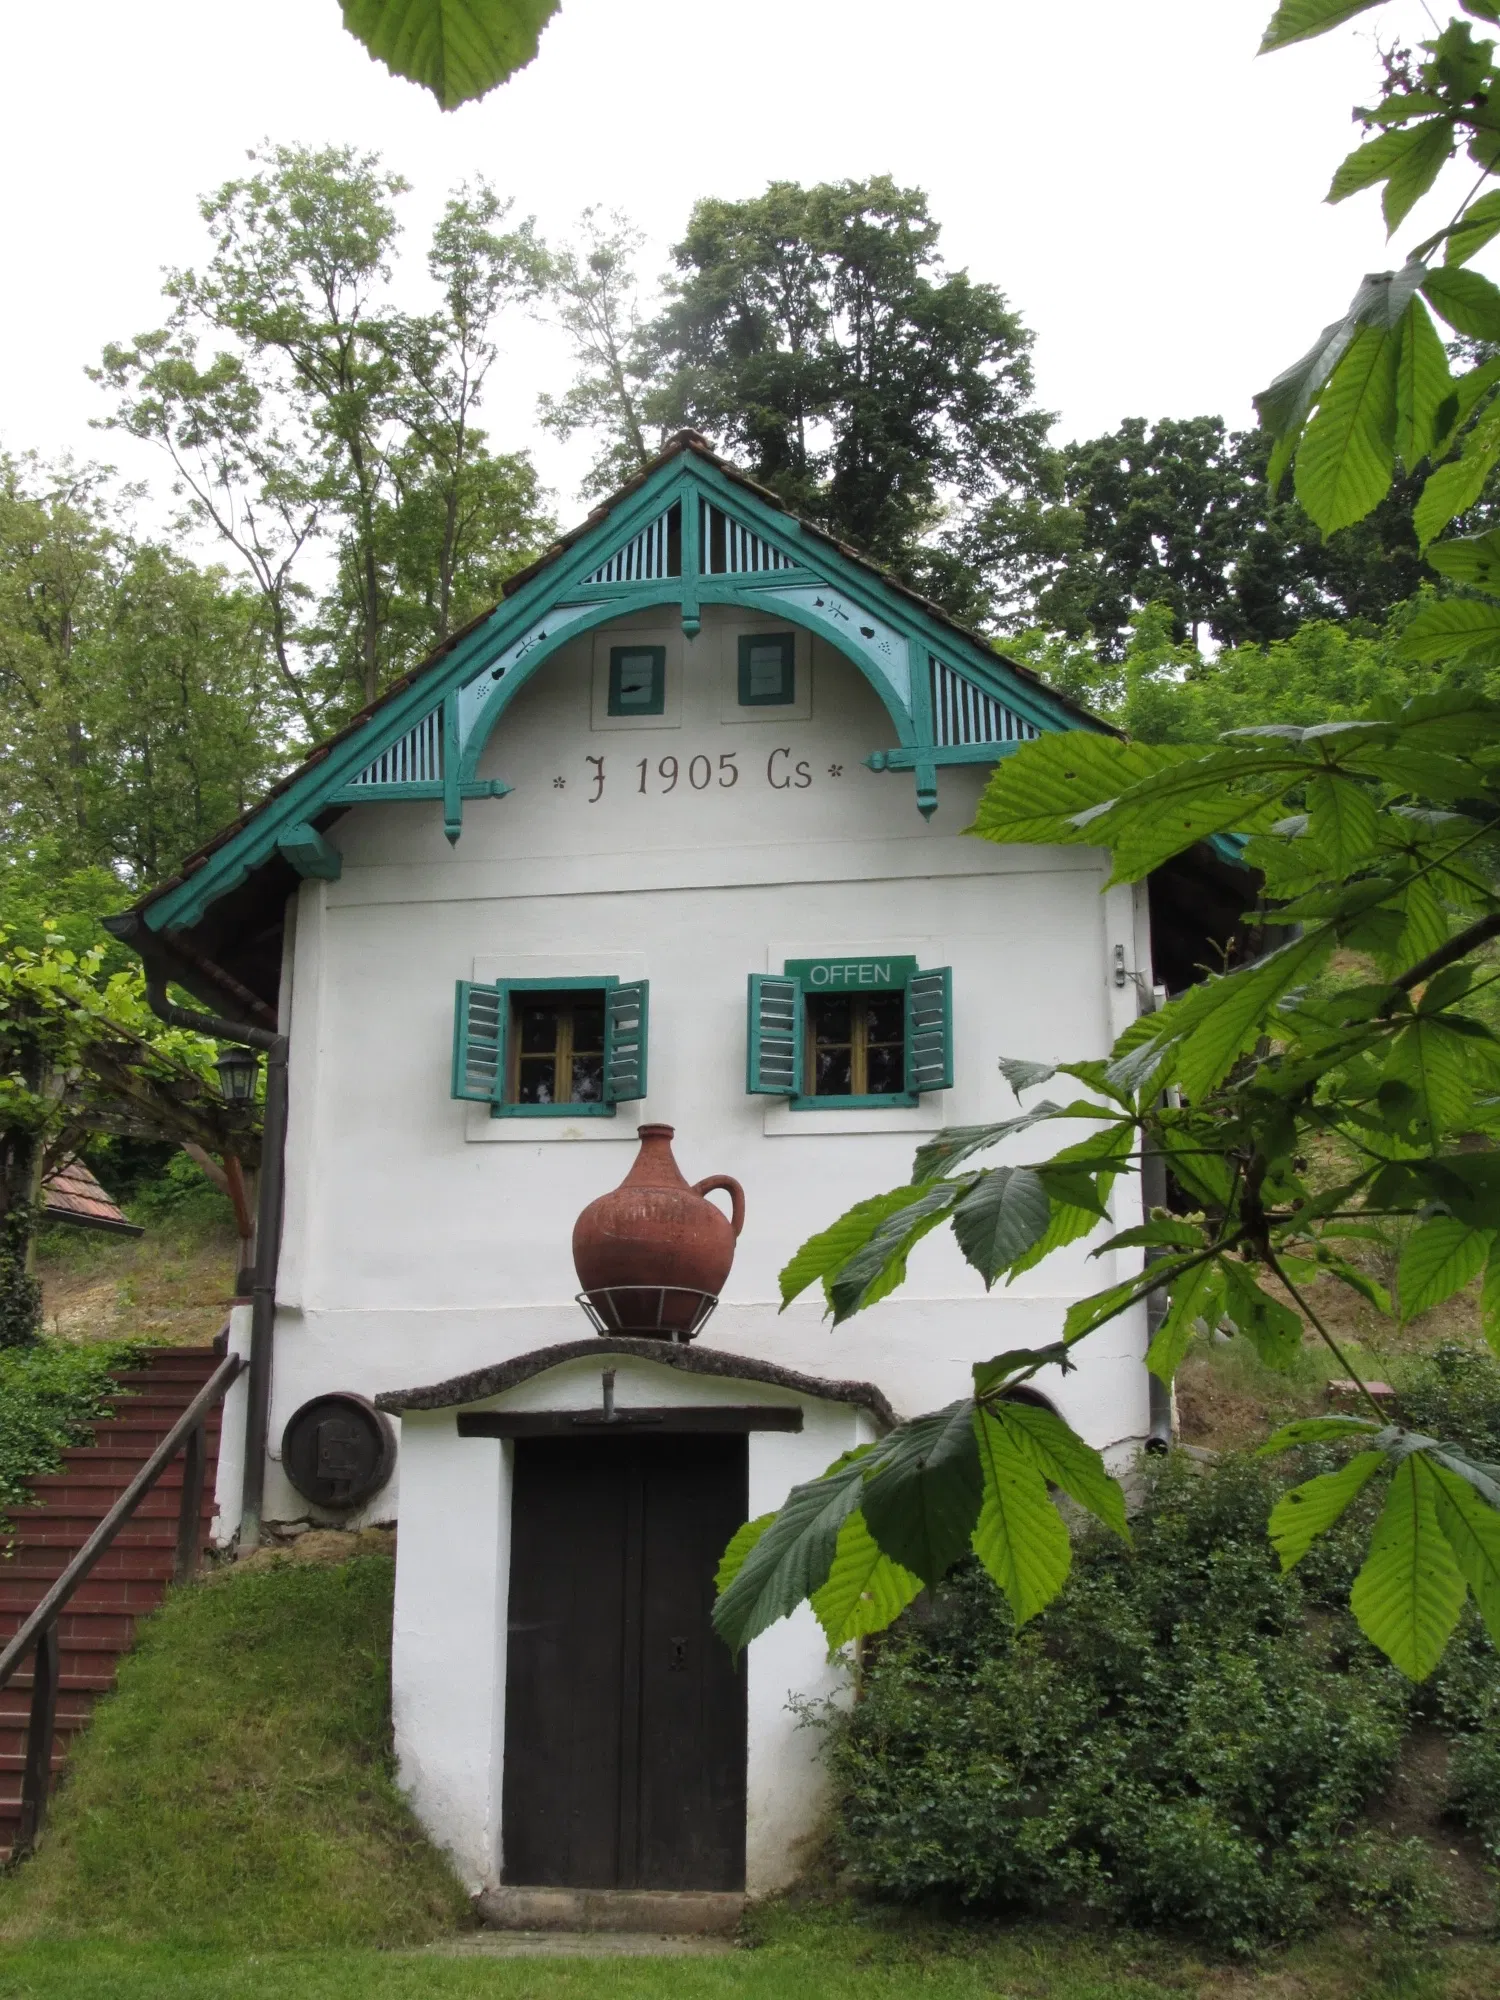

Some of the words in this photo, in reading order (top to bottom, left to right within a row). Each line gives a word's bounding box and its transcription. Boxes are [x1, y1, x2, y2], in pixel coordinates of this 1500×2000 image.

[636, 752, 739, 794] 1905
[767, 747, 812, 789] Cs
[810, 963, 891, 985] OFFEN
